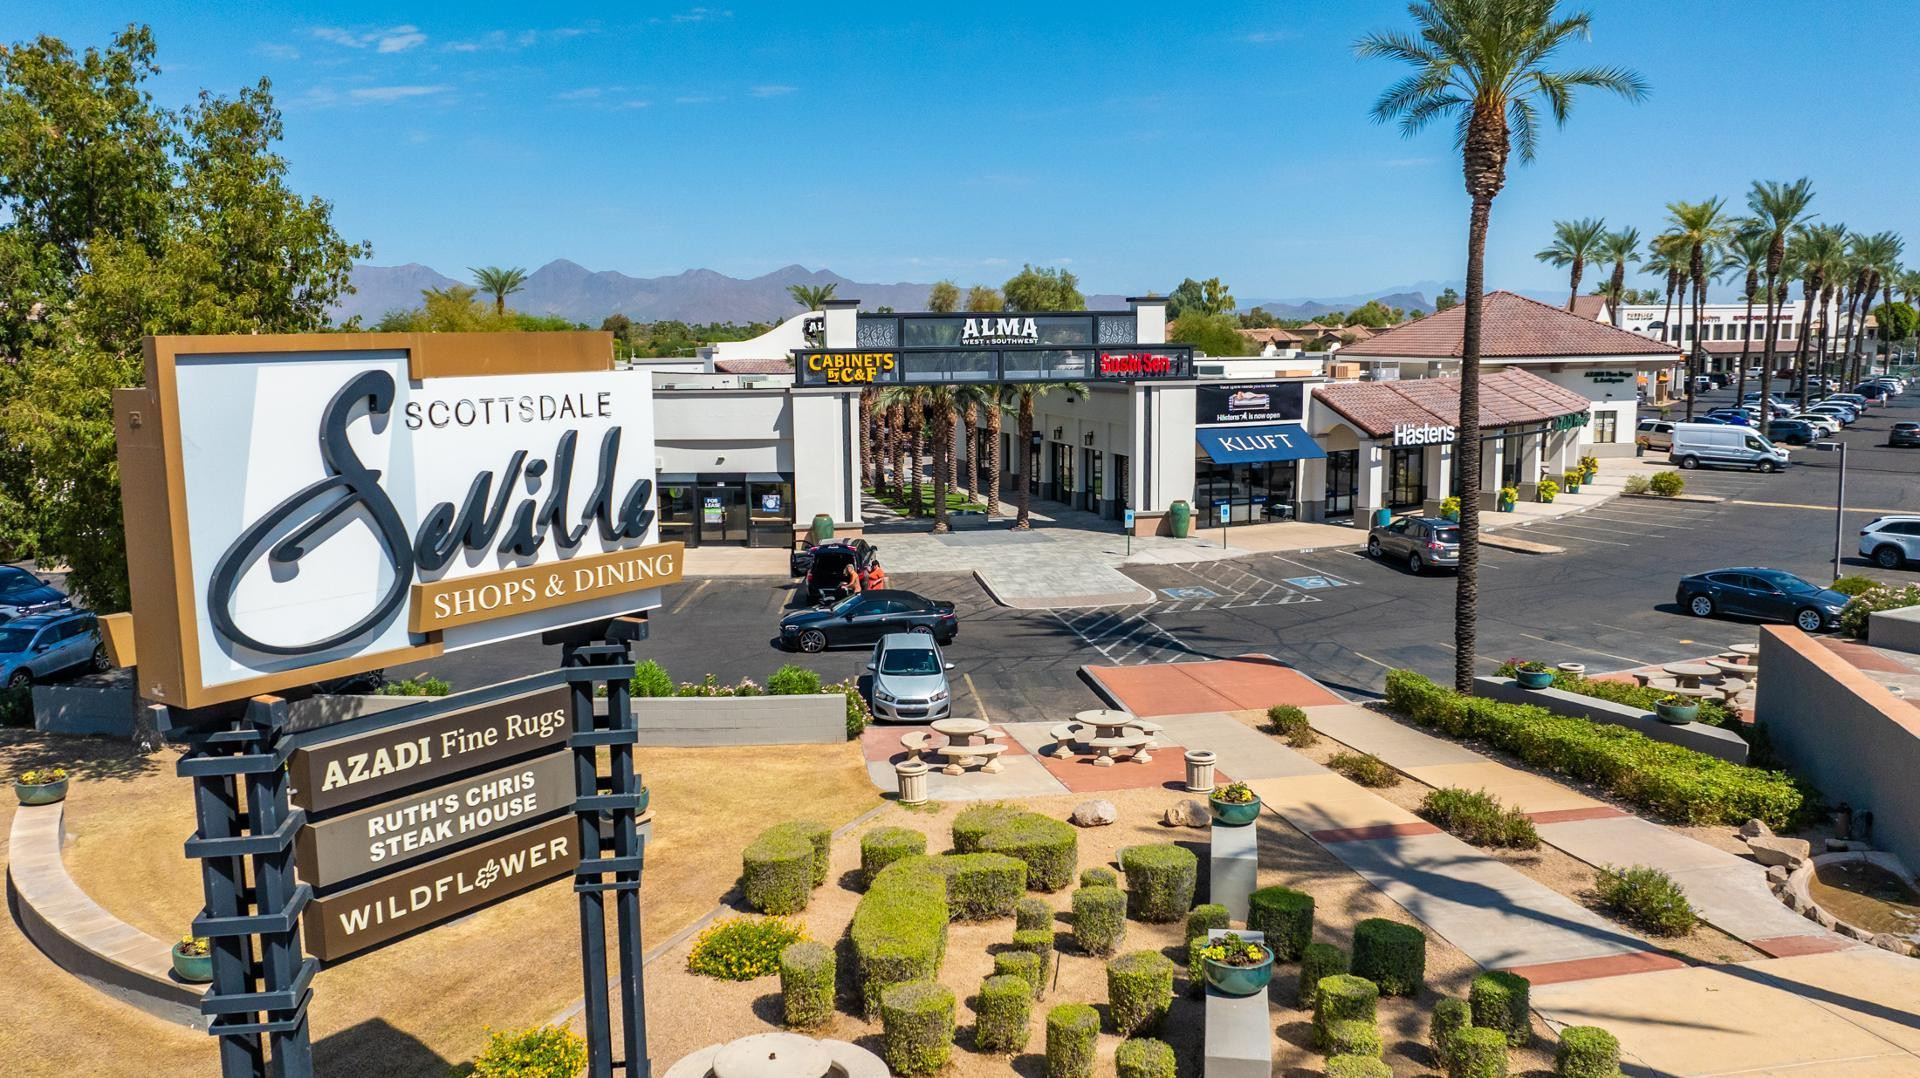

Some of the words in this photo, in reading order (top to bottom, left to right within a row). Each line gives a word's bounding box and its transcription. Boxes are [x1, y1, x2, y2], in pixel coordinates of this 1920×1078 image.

[962, 318, 1038, 339] ALMA
[809, 353, 894, 371] CABINETS
[1101, 353, 1141, 373] Sushi
[841, 367, 877, 383] C&F
[405, 391, 612, 430] SCOTTSDALE
[1266, 413, 1280, 421] open
[1218, 434, 1293, 452] KLUFT
[1394, 422, 1456, 446] Hästens
[434, 578, 537, 619] SHOPS
[544, 574, 567, 599] &
[574, 553, 674, 593] DINING
[321, 736, 432, 792] AZADI
[440, 728, 498, 760] Fine
[505, 708, 566, 738] Rugs
[367, 794, 460, 838] RUTH'S
[465, 771, 535, 808] CHRIS
[369, 820, 454, 862] STEAK
[459, 793, 537, 835] HOUSE
